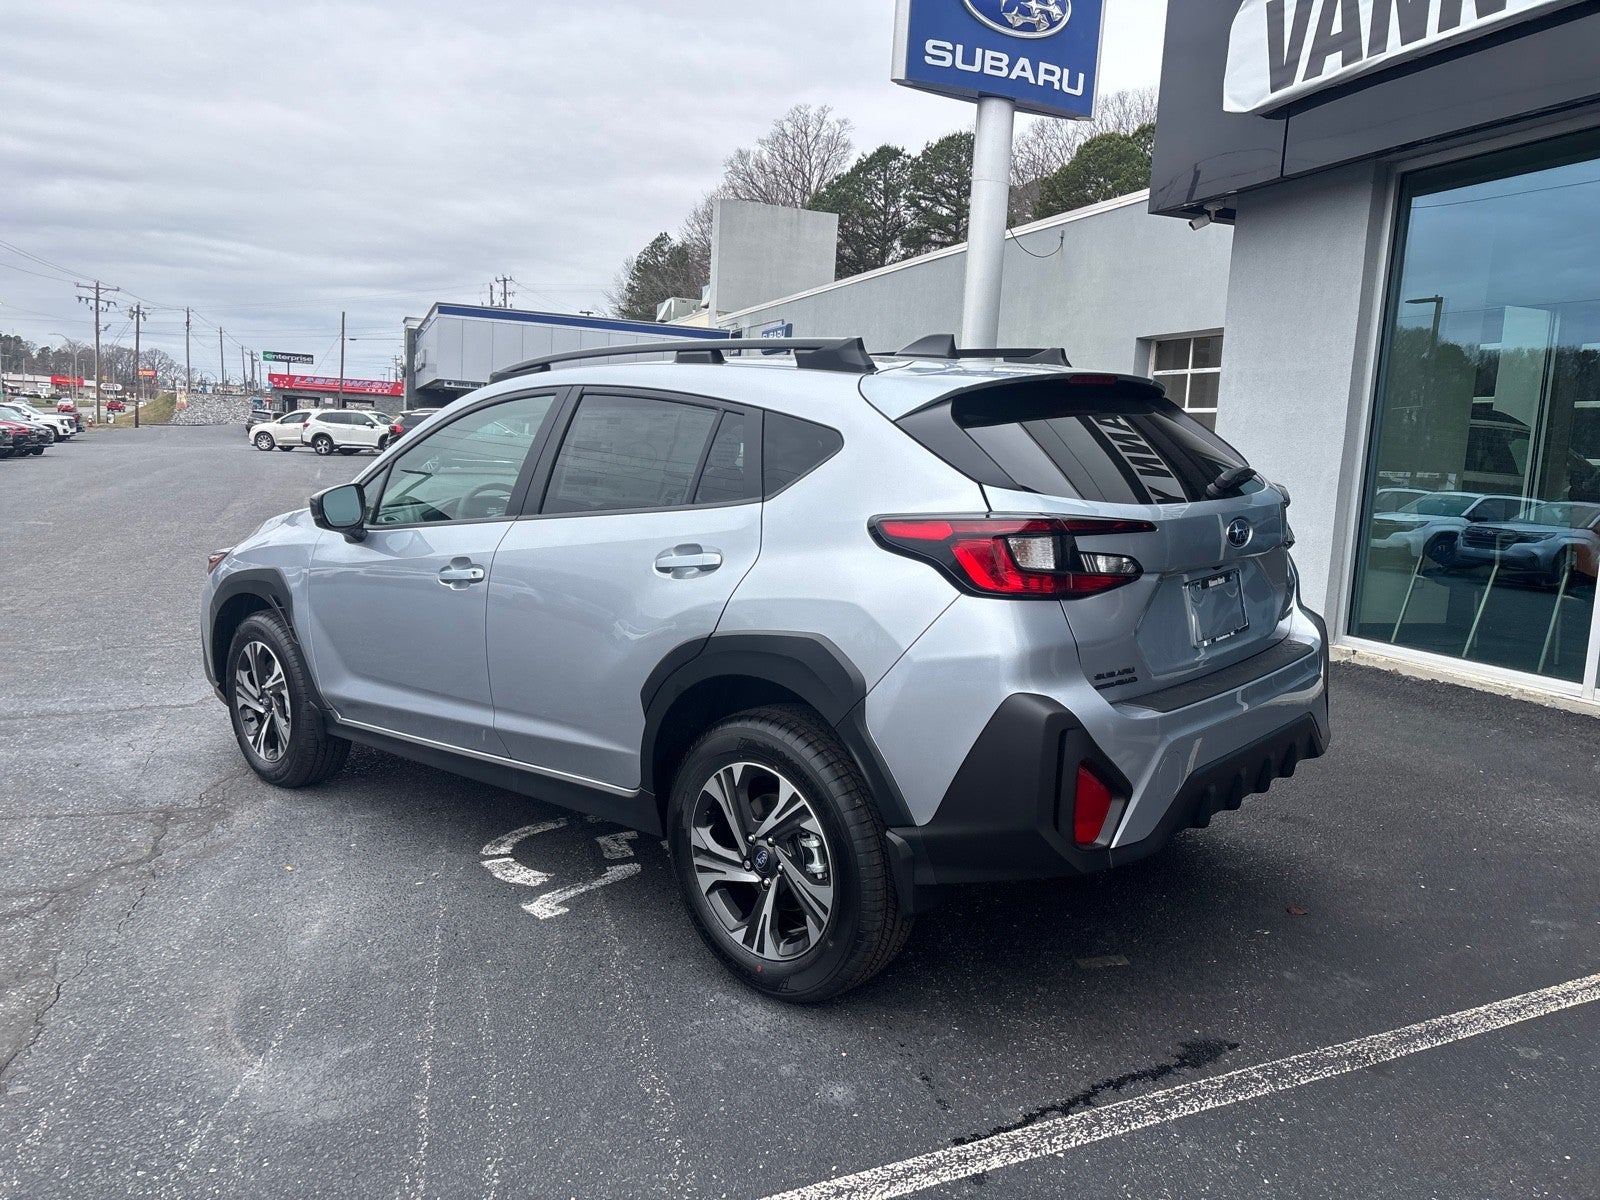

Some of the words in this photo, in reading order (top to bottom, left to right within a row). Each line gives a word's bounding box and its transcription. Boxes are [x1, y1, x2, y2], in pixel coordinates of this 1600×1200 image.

[924, 39, 1084, 96] SUBARU
[264, 353, 313, 362] enterprise
[1093, 666, 1135, 681] SUBARU
